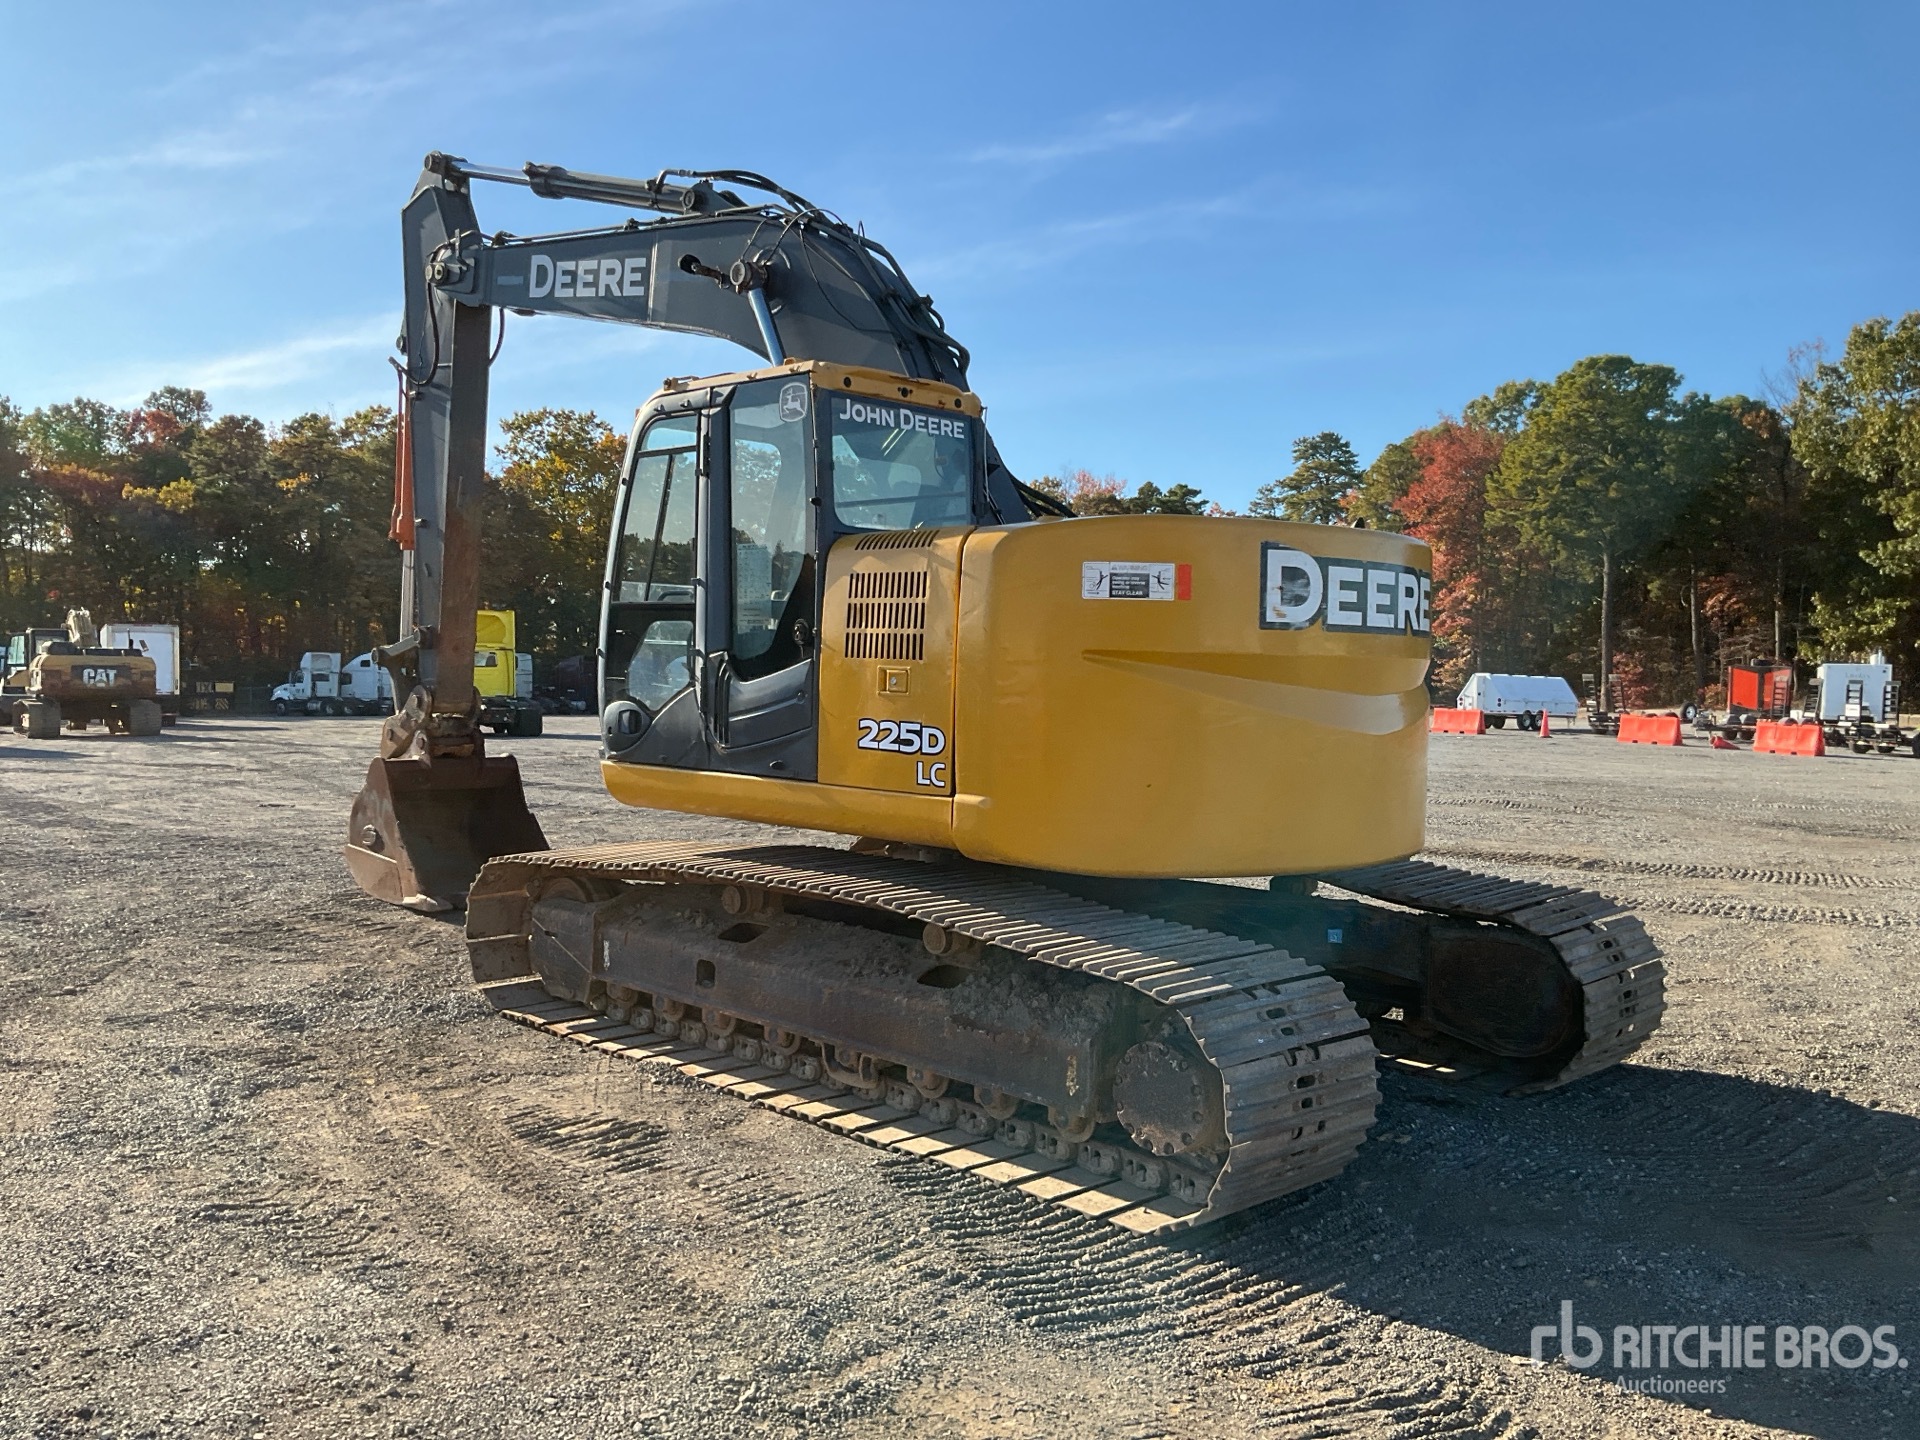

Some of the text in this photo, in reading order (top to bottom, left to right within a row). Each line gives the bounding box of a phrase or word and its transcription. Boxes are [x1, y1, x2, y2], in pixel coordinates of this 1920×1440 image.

[528, 254, 647, 298] DEERE
[839, 399, 965, 439] JOHN DEERE
[1266, 549, 1431, 632] DEERE
[82, 668, 117, 687] CAT
[858, 718, 946, 755] 225D
[917, 761, 946, 788] LC
